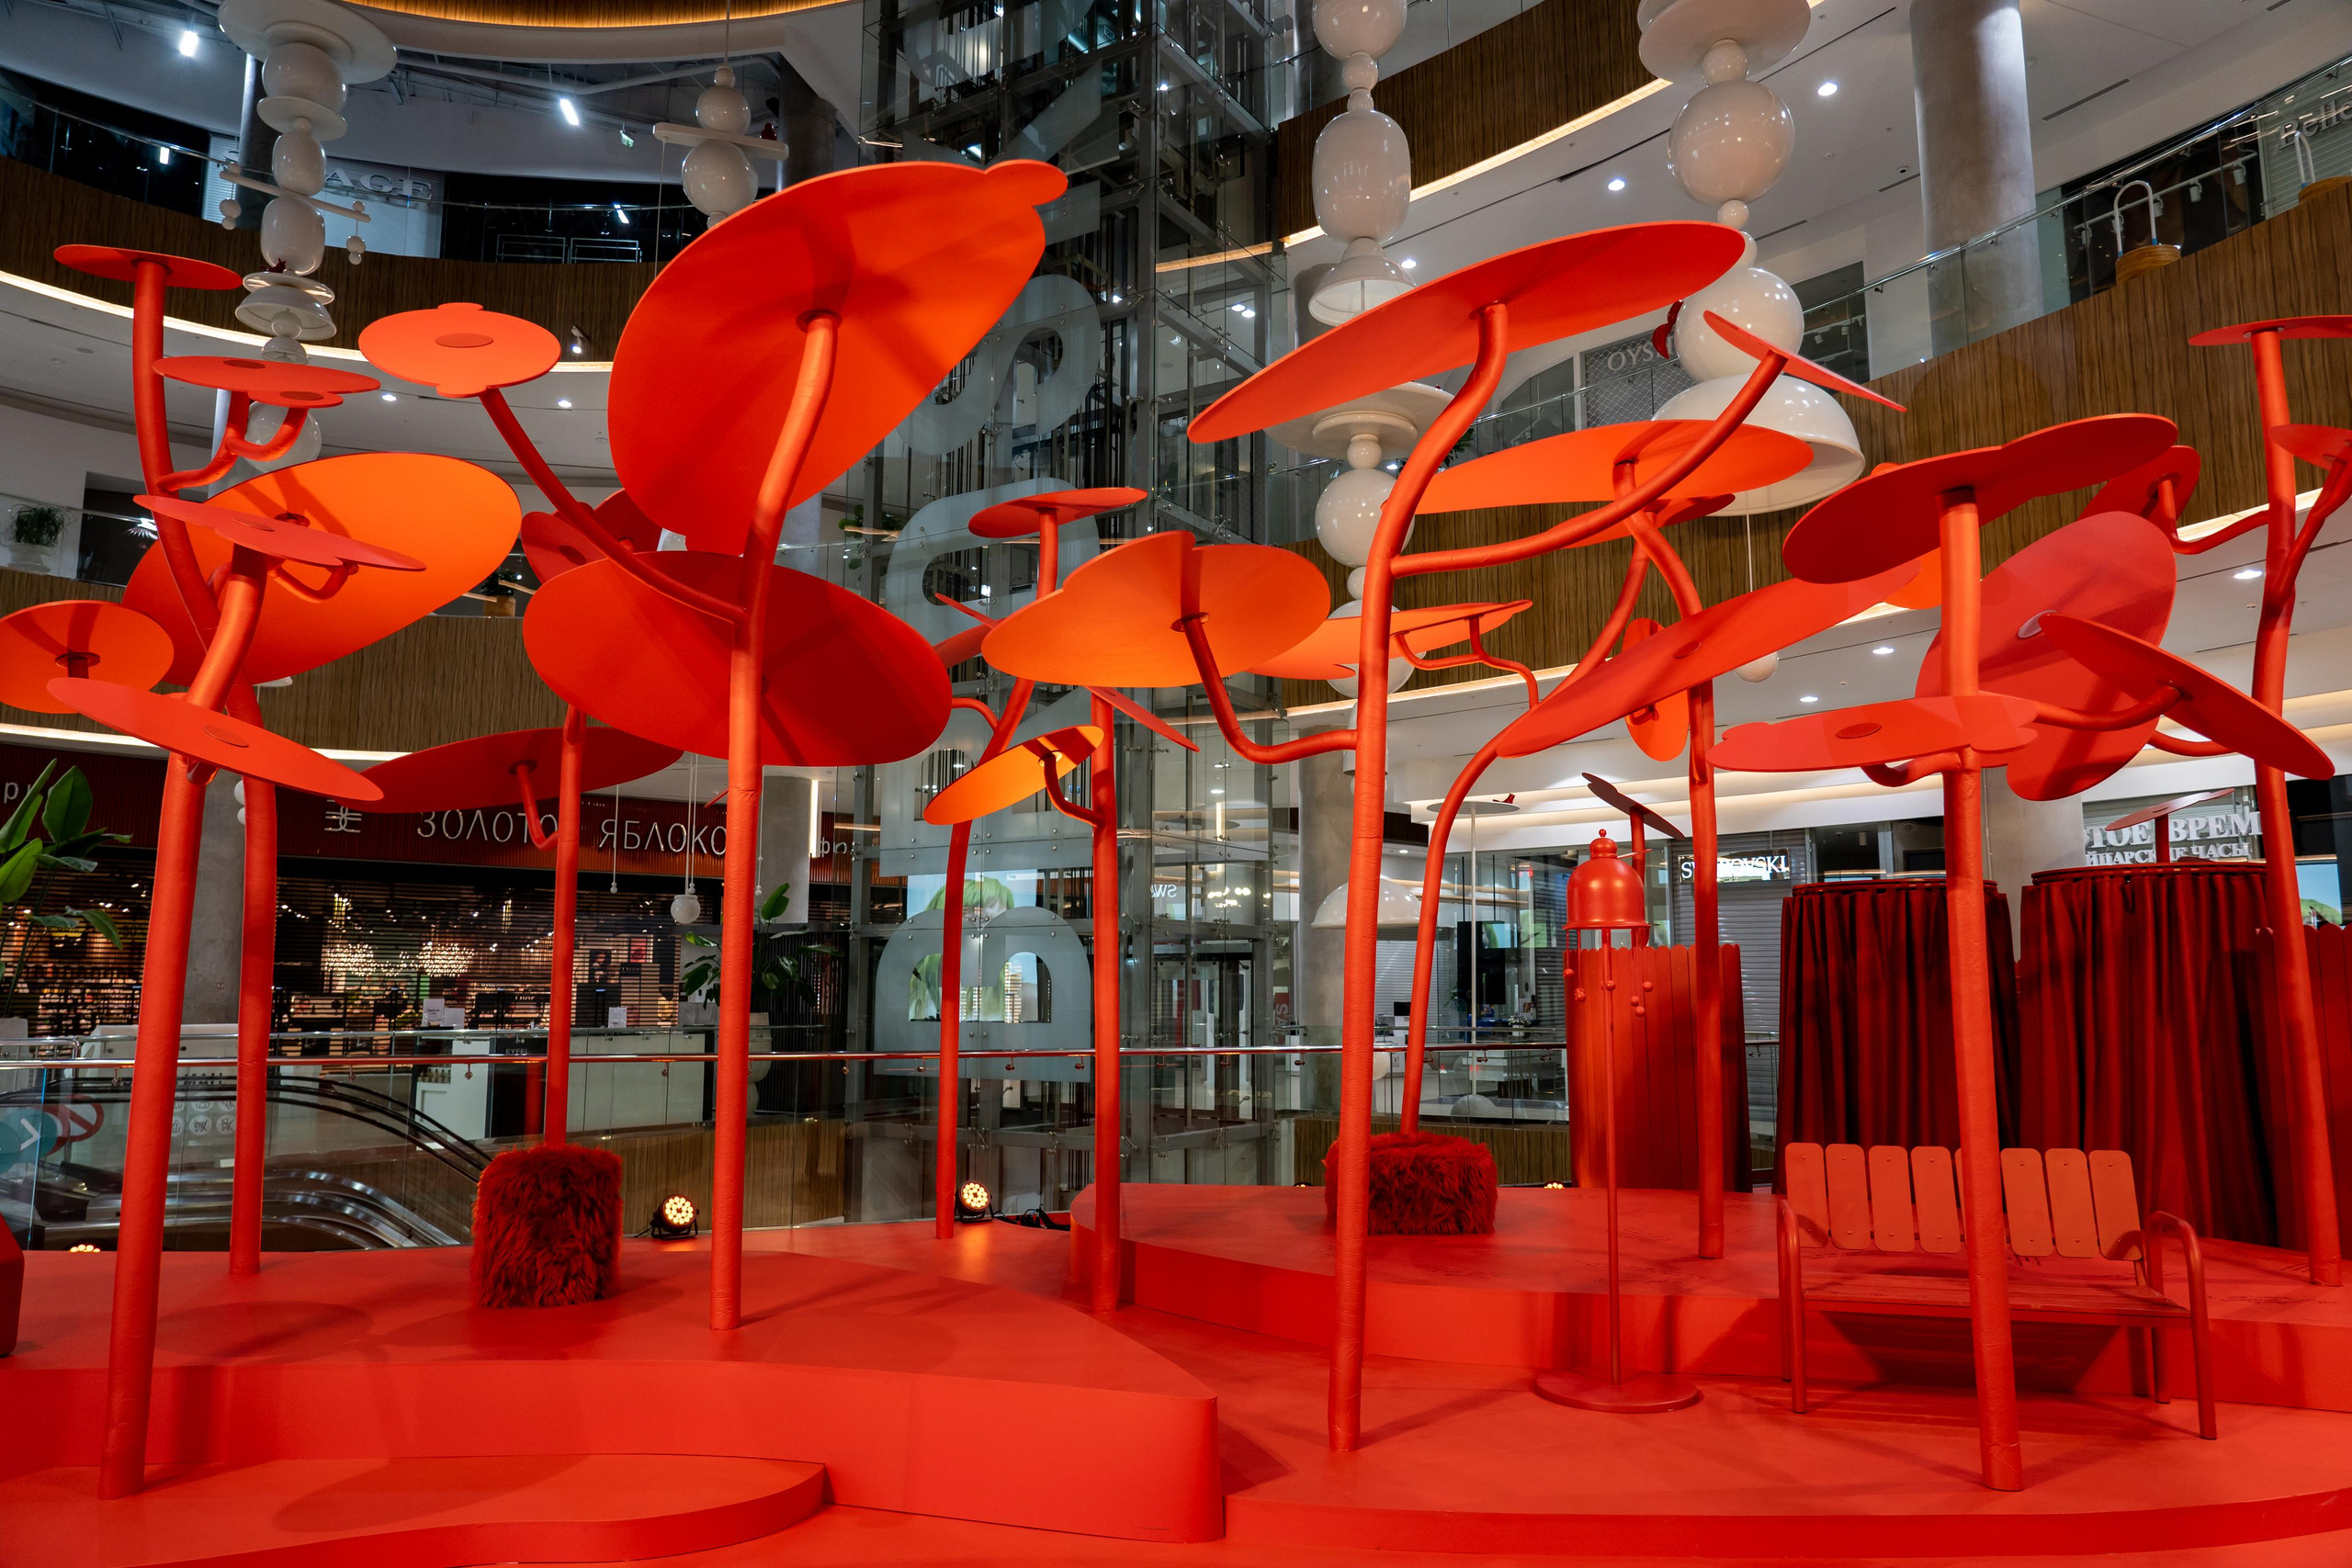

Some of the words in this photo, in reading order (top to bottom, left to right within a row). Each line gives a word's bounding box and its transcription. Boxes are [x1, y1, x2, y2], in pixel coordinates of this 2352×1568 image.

[1607, 335, 1673, 371] OYS
[417, 809, 559, 844] ЗОЛОТО
[599, 818, 727, 855] ЯБЛОКО
[2168, 811, 2263, 842] ВРЕМ
[2190, 842, 2250, 860] ЧАСЫ
[1681, 855, 1787, 879] SOVSKI
